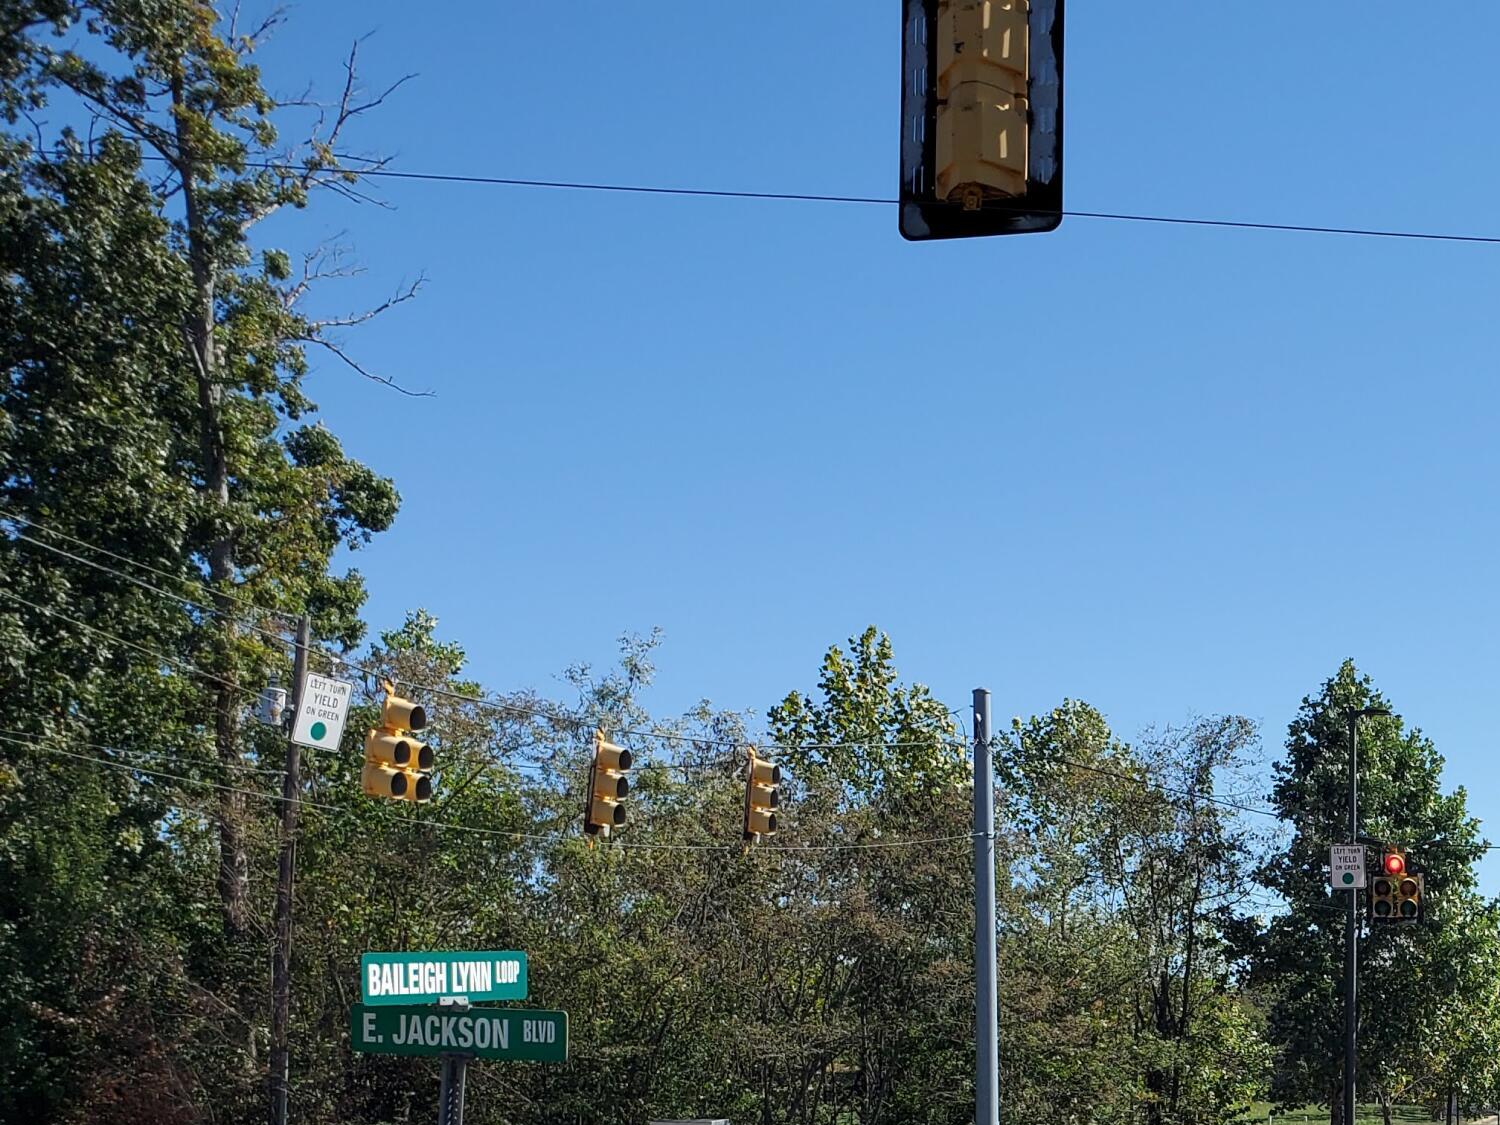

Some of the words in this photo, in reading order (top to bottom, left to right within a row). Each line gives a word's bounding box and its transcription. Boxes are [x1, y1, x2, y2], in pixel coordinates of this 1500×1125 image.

[310, 678, 327, 691] LEFT
[329, 683, 347, 696] TURN
[314, 692, 339, 709] YIELD
[305, 705, 316, 716] ON
[317, 709, 340, 721] GREEN
[1333, 847, 1346, 855] LEFT
[1347, 847, 1361, 855] TURN
[1338, 855, 1357, 863] YIELD
[367, 961, 447, 997] BAILEIGH
[451, 960, 492, 993] LYNN
[495, 960, 520, 984] LOOP
[362, 1012, 384, 1044] E.
[392, 1014, 509, 1049] JACKSON
[522, 1019, 556, 1044] BLVD
